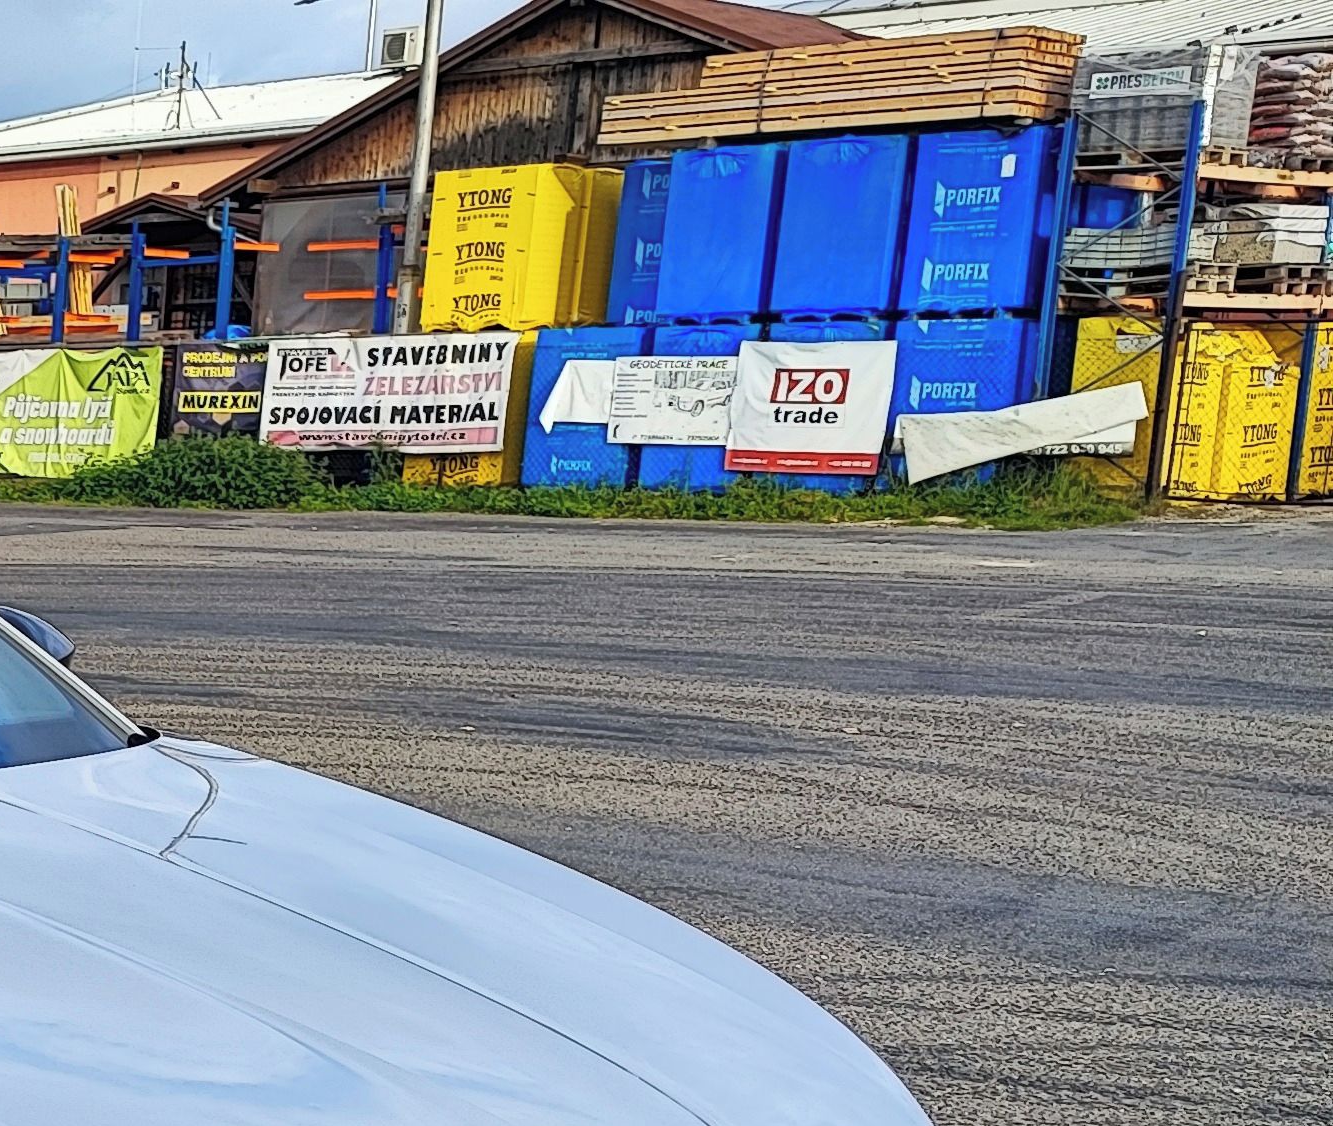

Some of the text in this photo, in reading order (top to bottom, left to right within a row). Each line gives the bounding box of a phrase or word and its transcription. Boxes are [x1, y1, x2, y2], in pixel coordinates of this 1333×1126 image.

[1109, 70, 1185, 89] PRESBETON
[457, 188, 513, 208] YTONG
[946, 186, 1001, 206] PORFIX
[455, 241, 505, 260] YTONG
[933, 263, 989, 281] PORFIX
[452, 293, 501, 311] YTONG
[239, 353, 249, 363] A
[367, 341, 509, 367] STAVEBNINY
[182, 366, 236, 378] CENTRUM
[1181, 361, 1209, 380] TONG
[363, 365, 504, 396] ŽELEZÁŘSTVÍ
[775, 371, 844, 402] IZO
[921, 382, 977, 399] PORFIX
[2, 393, 81, 424] Půjčovna
[182, 394, 259, 409] MUREXIN
[268, 396, 499, 425] SPOJOVACÍ MATERIÁL
[773, 406, 839, 424] trade
[0, 420, 116, 446] a snowboardů
[1173, 423, 1202, 442] TONG
[1243, 422, 1278, 443] YTONG
